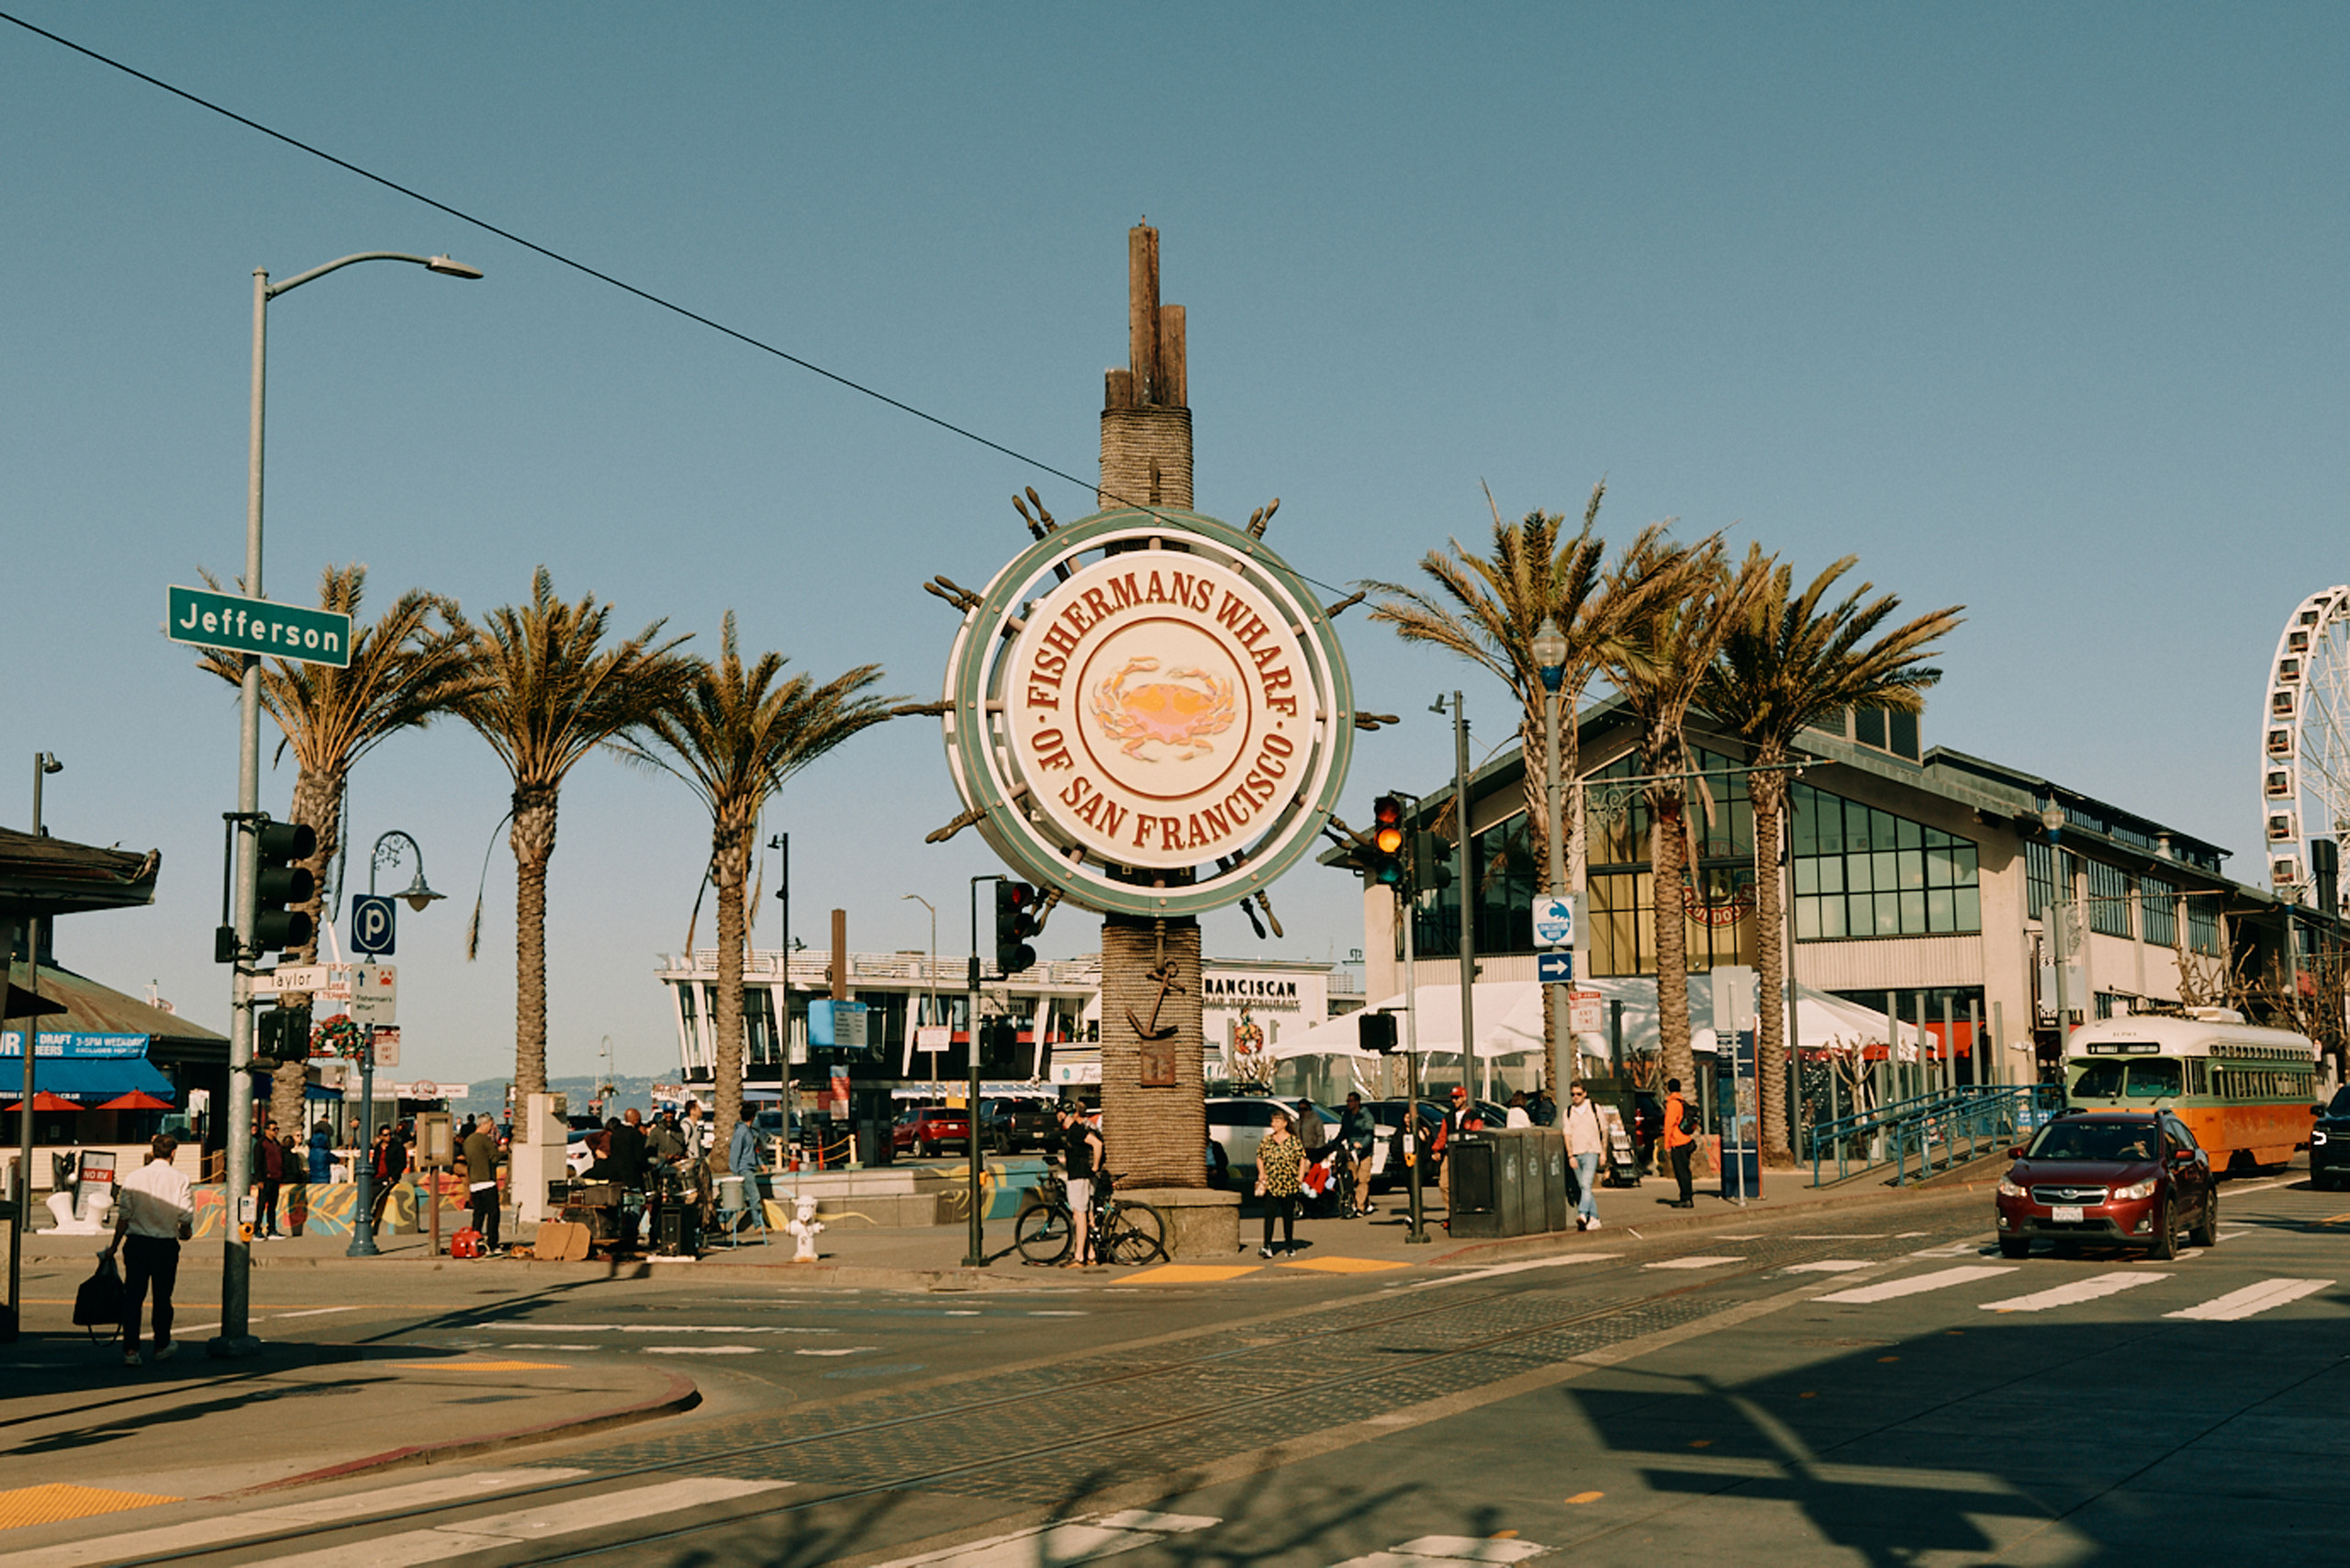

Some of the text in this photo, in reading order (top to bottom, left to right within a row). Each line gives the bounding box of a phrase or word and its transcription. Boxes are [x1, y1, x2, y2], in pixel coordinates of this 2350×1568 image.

[179, 602, 339, 653] Jefferson
[1026, 570, 1297, 718] FISHERMANS WHARF
[1031, 727, 1294, 851] OF SAN FRANCISCO
[272, 973, 312, 990] Taylor
[356, 994, 392, 1003] Fisherman's
[39, 1034, 72, 1045] DRAFT
[83, 1170, 108, 1180] NO RV
